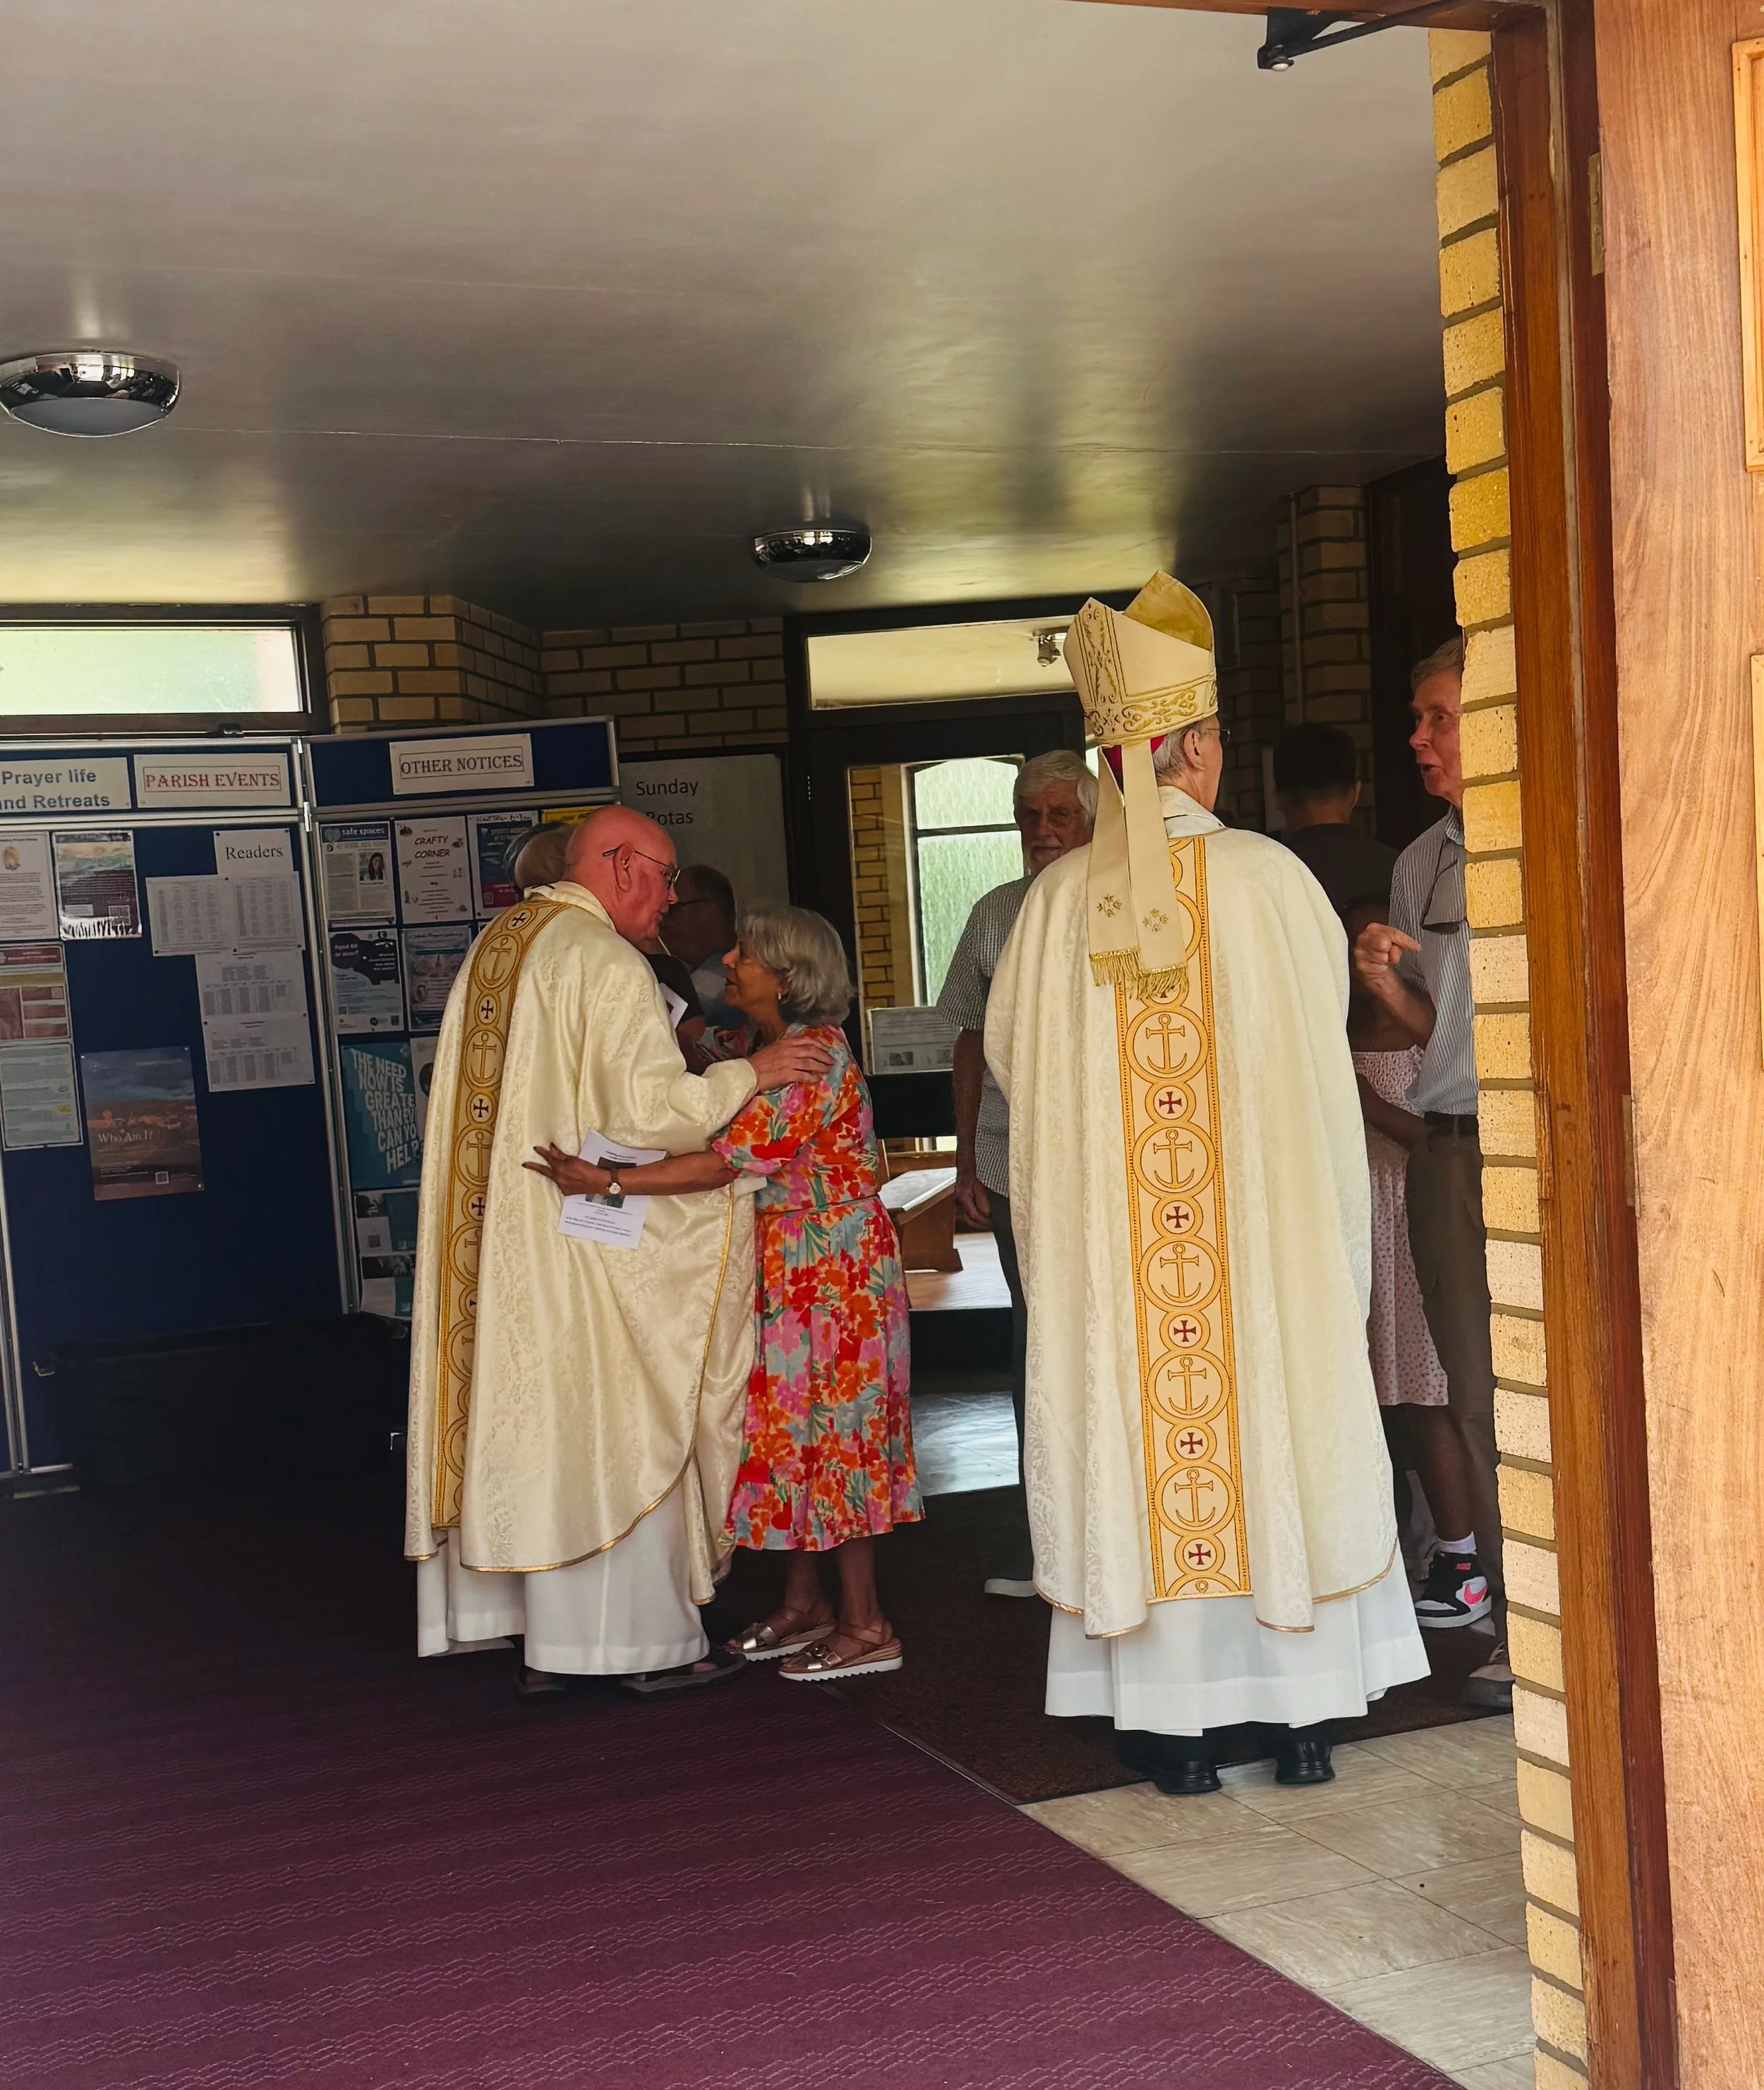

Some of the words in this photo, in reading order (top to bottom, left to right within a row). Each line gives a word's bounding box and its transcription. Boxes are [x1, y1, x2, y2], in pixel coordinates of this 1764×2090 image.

[401, 759, 452, 774] OTHER
[457, 755, 523, 771] NOTICES
[1, 771, 62, 787] Prayer
[68, 769, 96, 783] life
[146, 774, 209, 787] PARISH
[215, 772, 279, 787] EVENTS
[636, 778, 699, 797] Sunday
[33, 794, 110, 809] Retreats
[414, 835, 449, 845] CRAFTY
[225, 845, 284, 859] Readers
[414, 849, 449, 859] CORNER
[351, 1048, 373, 1073] THE
[375, 1056, 407, 1080] NEED
[358, 1068, 388, 1091] NOW
[391, 1076, 404, 1093] IS
[365, 1091, 415, 1111] GREATE
[371, 1109, 403, 1132] THAN
[403, 1108, 415, 1125] EV
[97, 1132, 122, 1144] Who
[377, 1127, 403, 1153] CAN
[404, 1123, 416, 1142] YO
